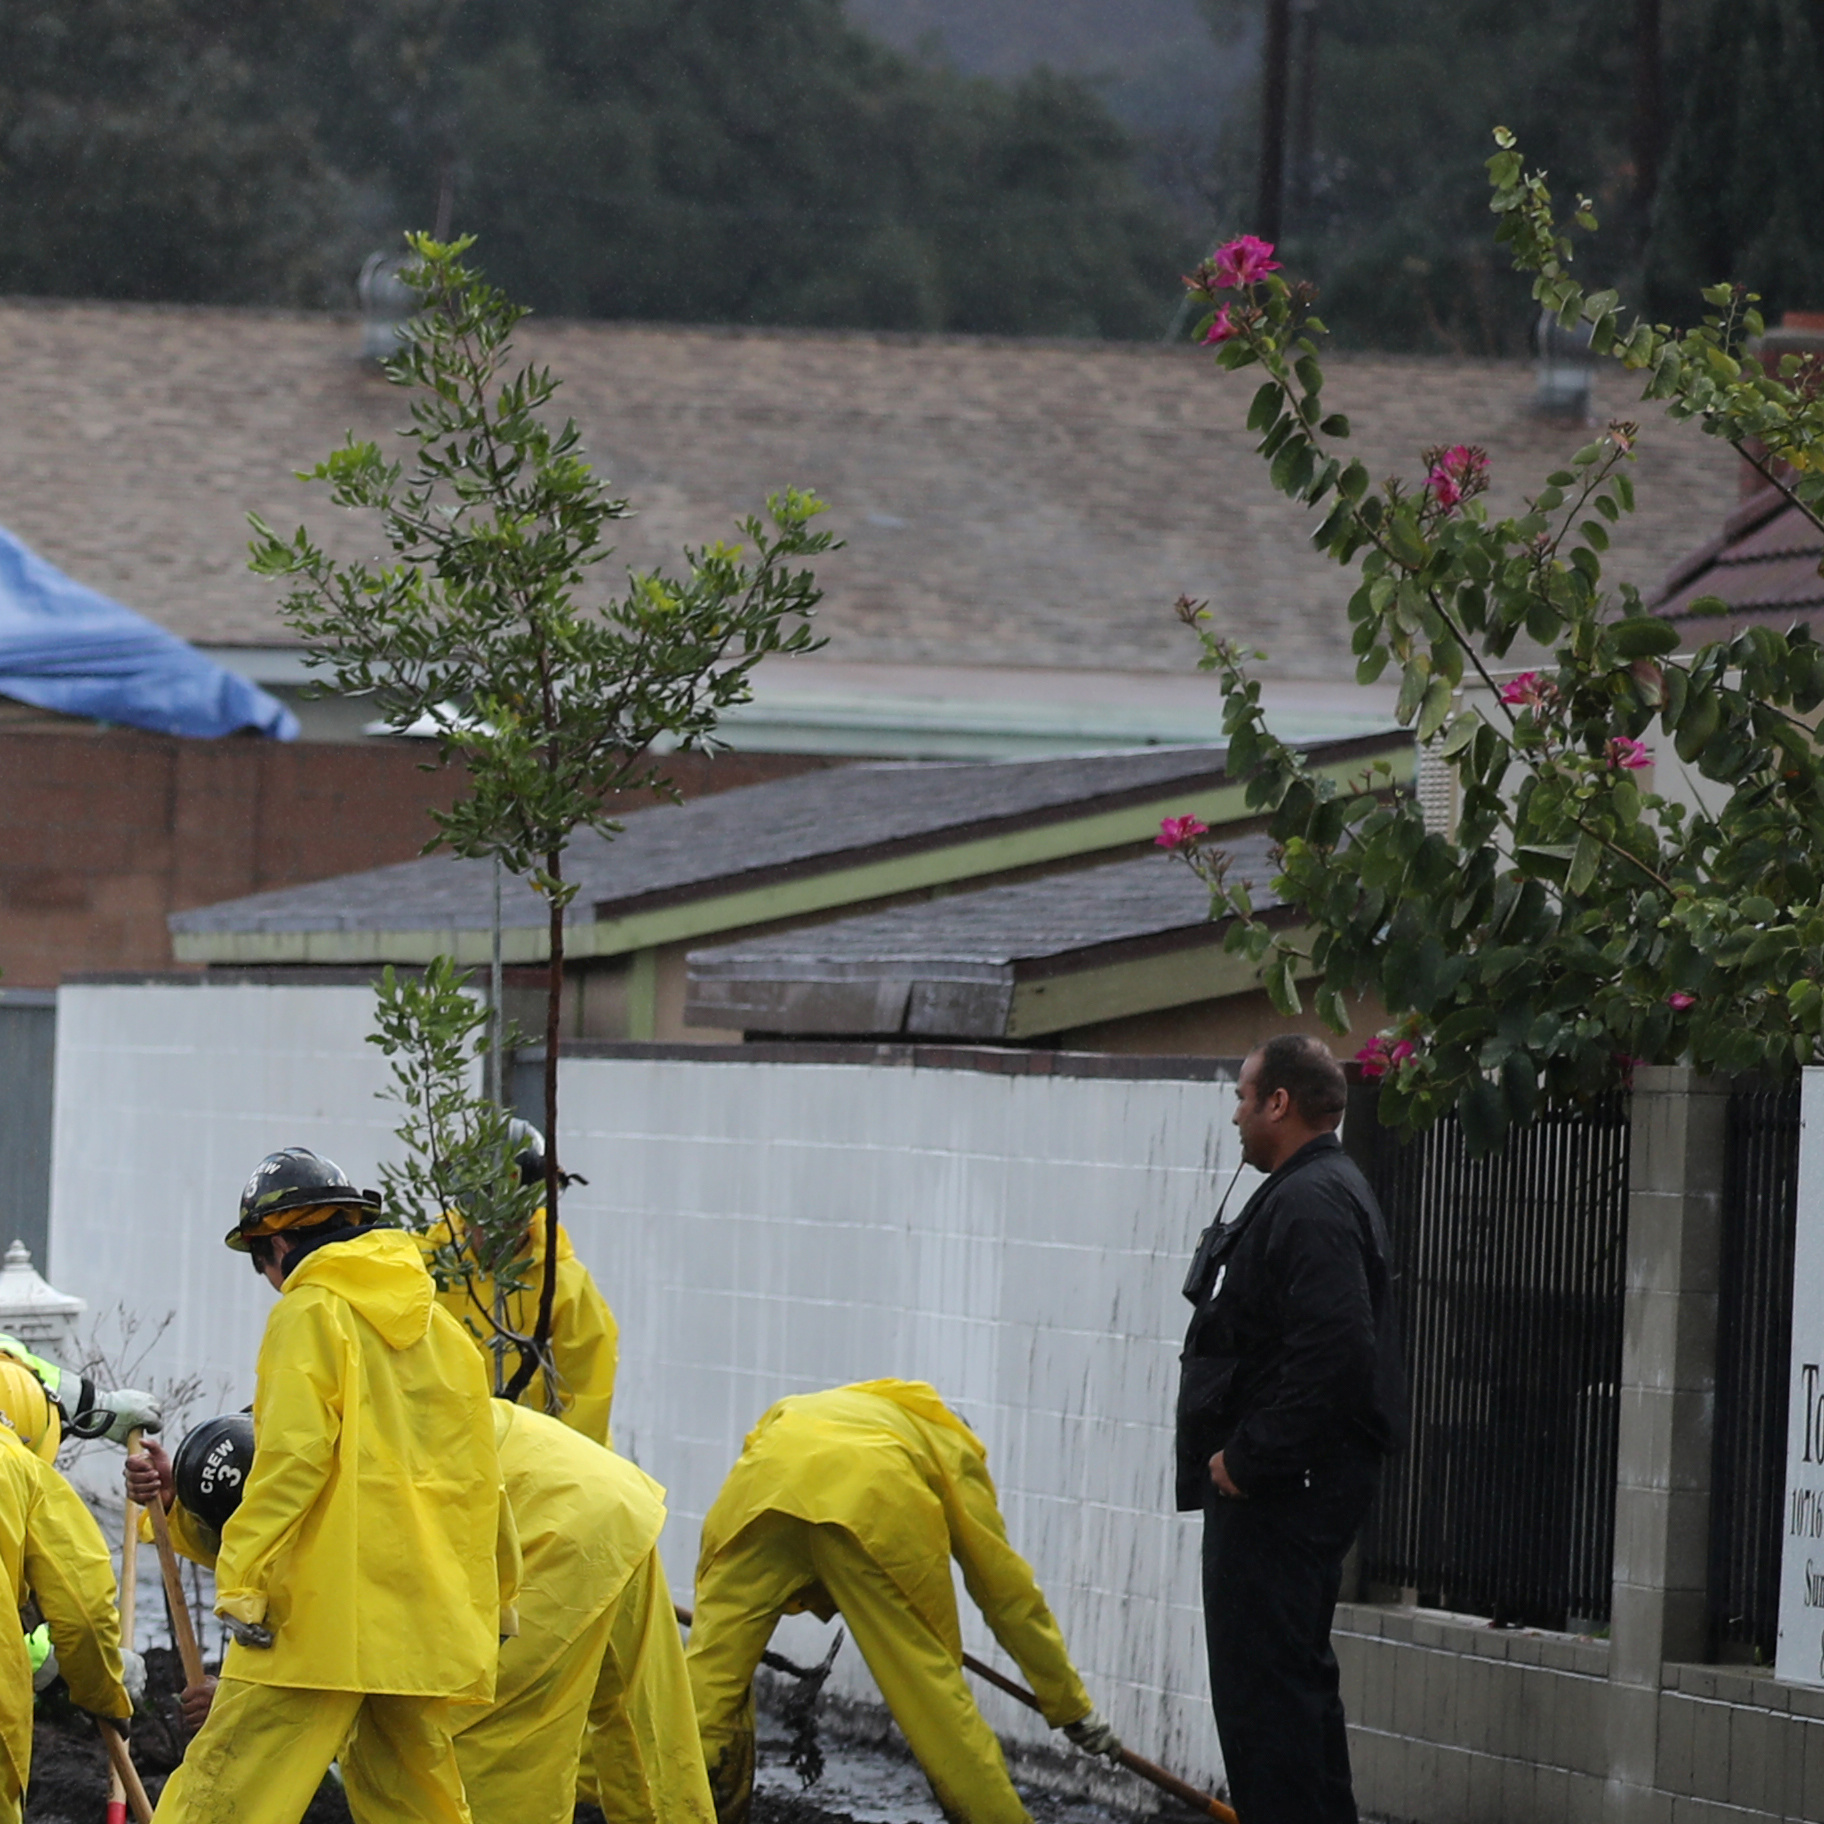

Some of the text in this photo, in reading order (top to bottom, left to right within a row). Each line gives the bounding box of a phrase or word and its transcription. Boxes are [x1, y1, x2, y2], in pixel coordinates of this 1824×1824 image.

[245, 1175, 259, 1199] 3
[200, 1438, 234, 1494] CREW
[217, 1464, 242, 1487] 3
[1790, 1488, 1824, 1539] 10716
